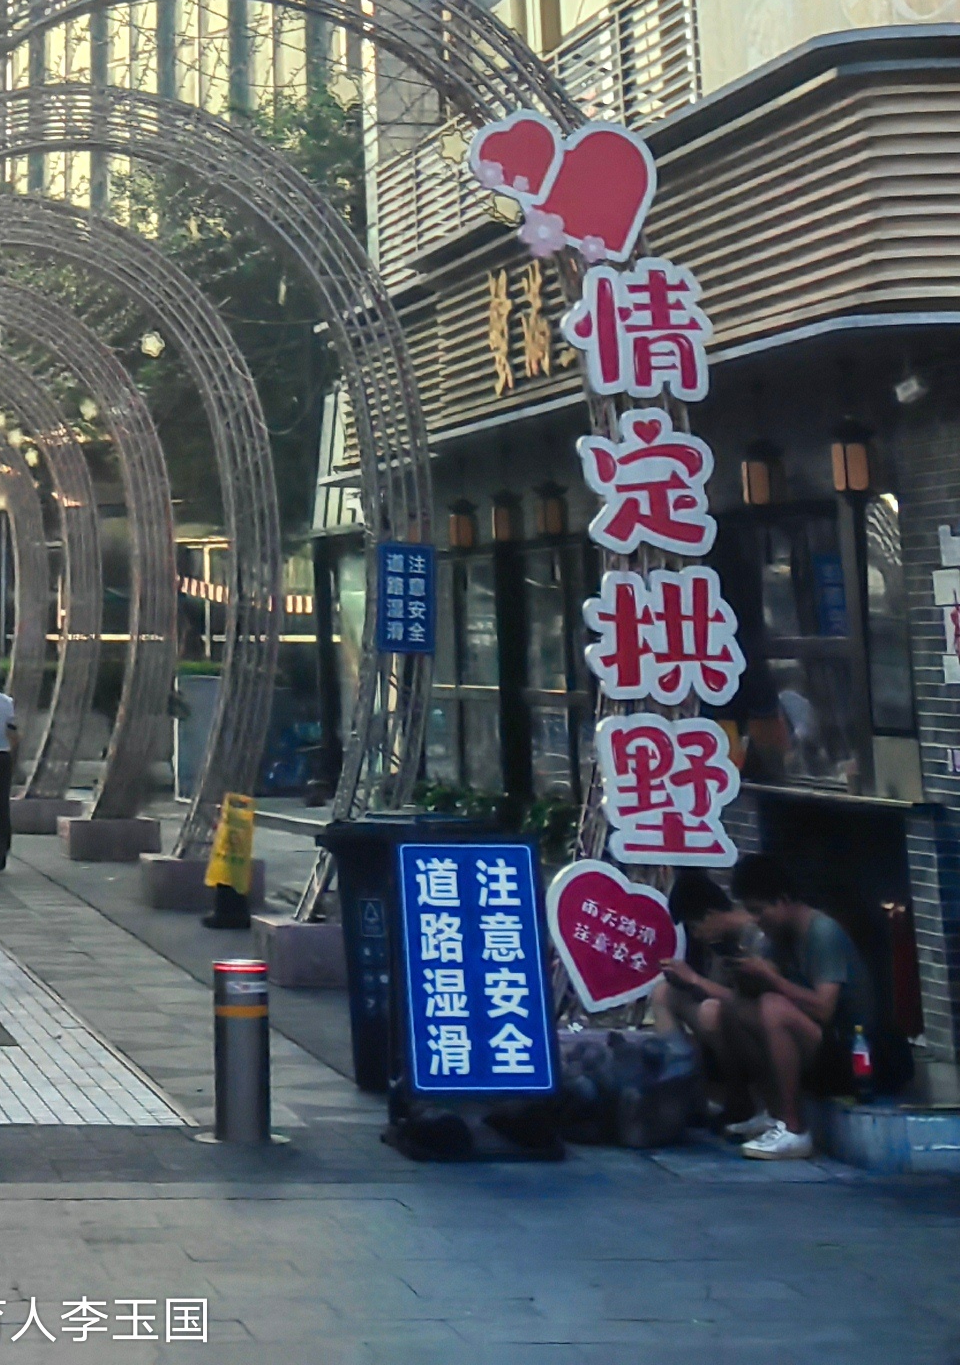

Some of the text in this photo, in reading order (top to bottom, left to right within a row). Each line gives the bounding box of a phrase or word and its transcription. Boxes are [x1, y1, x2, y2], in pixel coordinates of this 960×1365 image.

[407, 554, 426, 642] 注意安全
[575, 269, 732, 855] 情定拱墅
[415, 857, 472, 1076] 道路湿滑
[475, 857, 535, 1075] 注意安全
[573, 922, 648, 973] 注意安全
